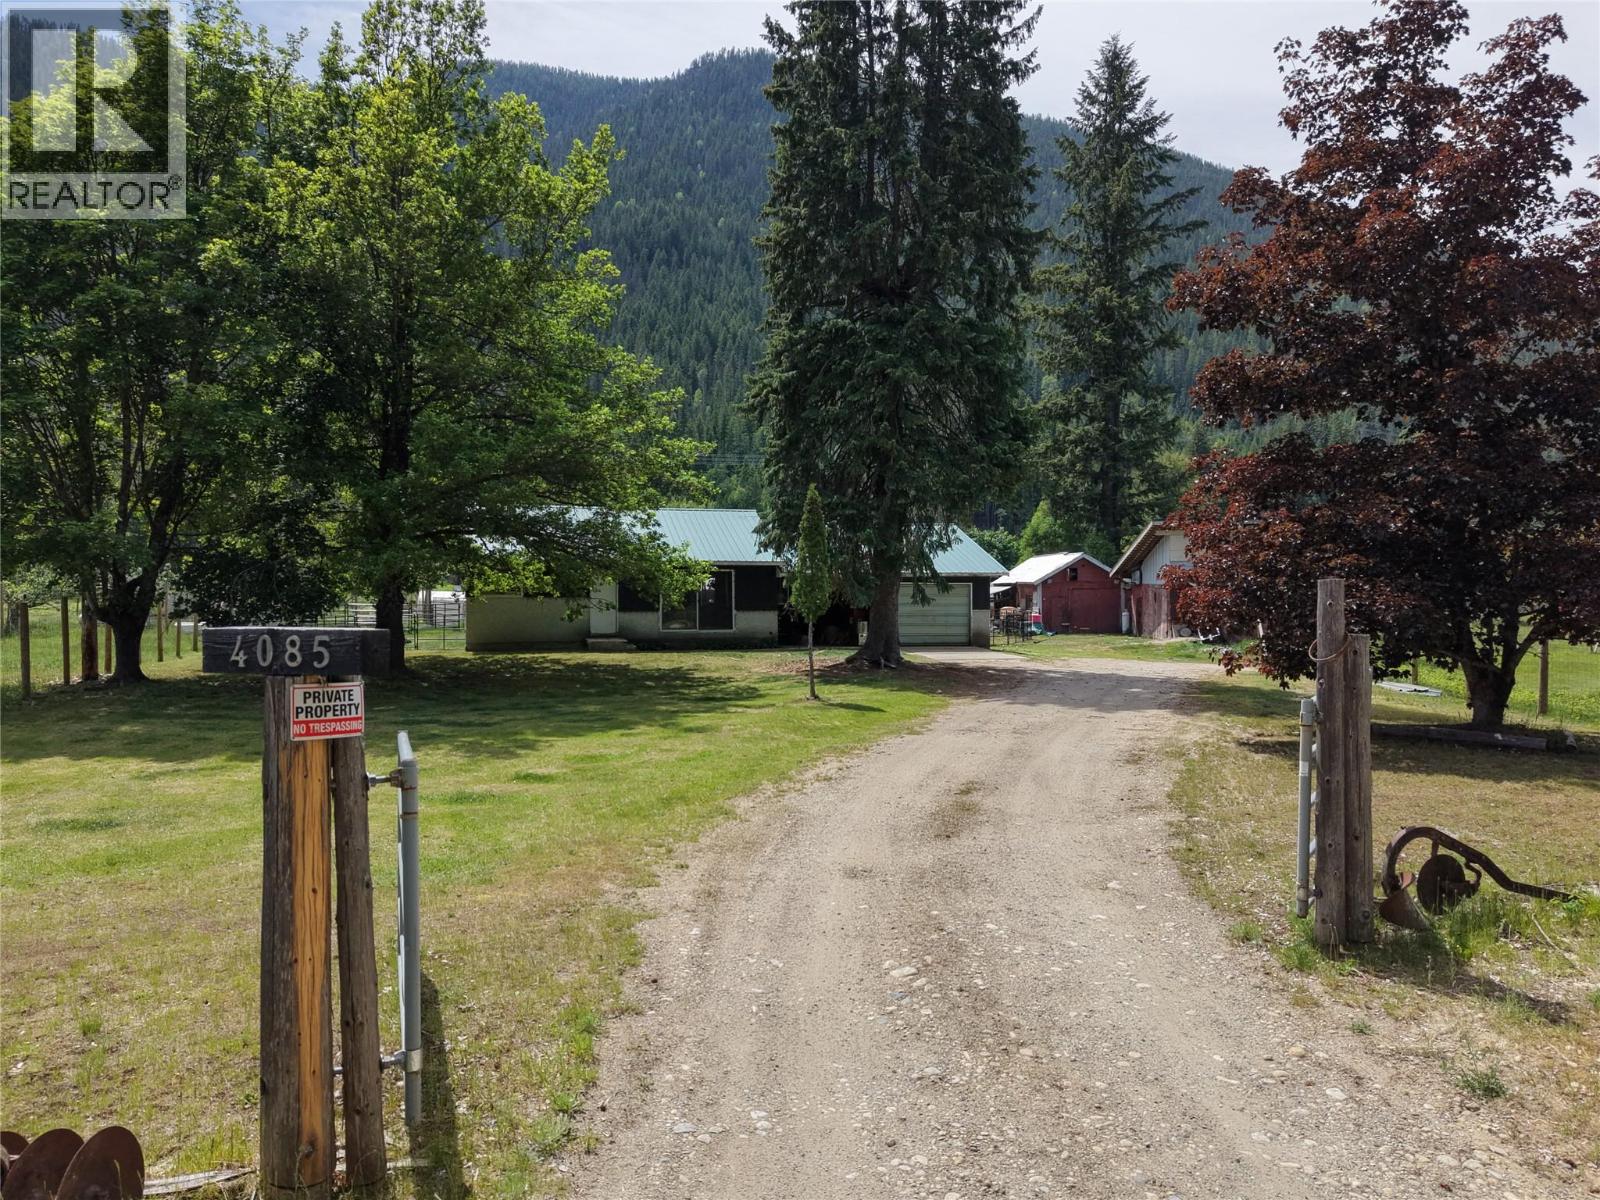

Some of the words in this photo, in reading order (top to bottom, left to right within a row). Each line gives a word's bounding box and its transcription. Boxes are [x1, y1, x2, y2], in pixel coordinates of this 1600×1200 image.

[230, 635, 331, 668] 4085
[303, 689, 354, 704] PRIVATE
[295, 703, 361, 719] PROPERTY
[293, 723, 307, 735] NO
[309, 720, 363, 733] TRESPASSING
